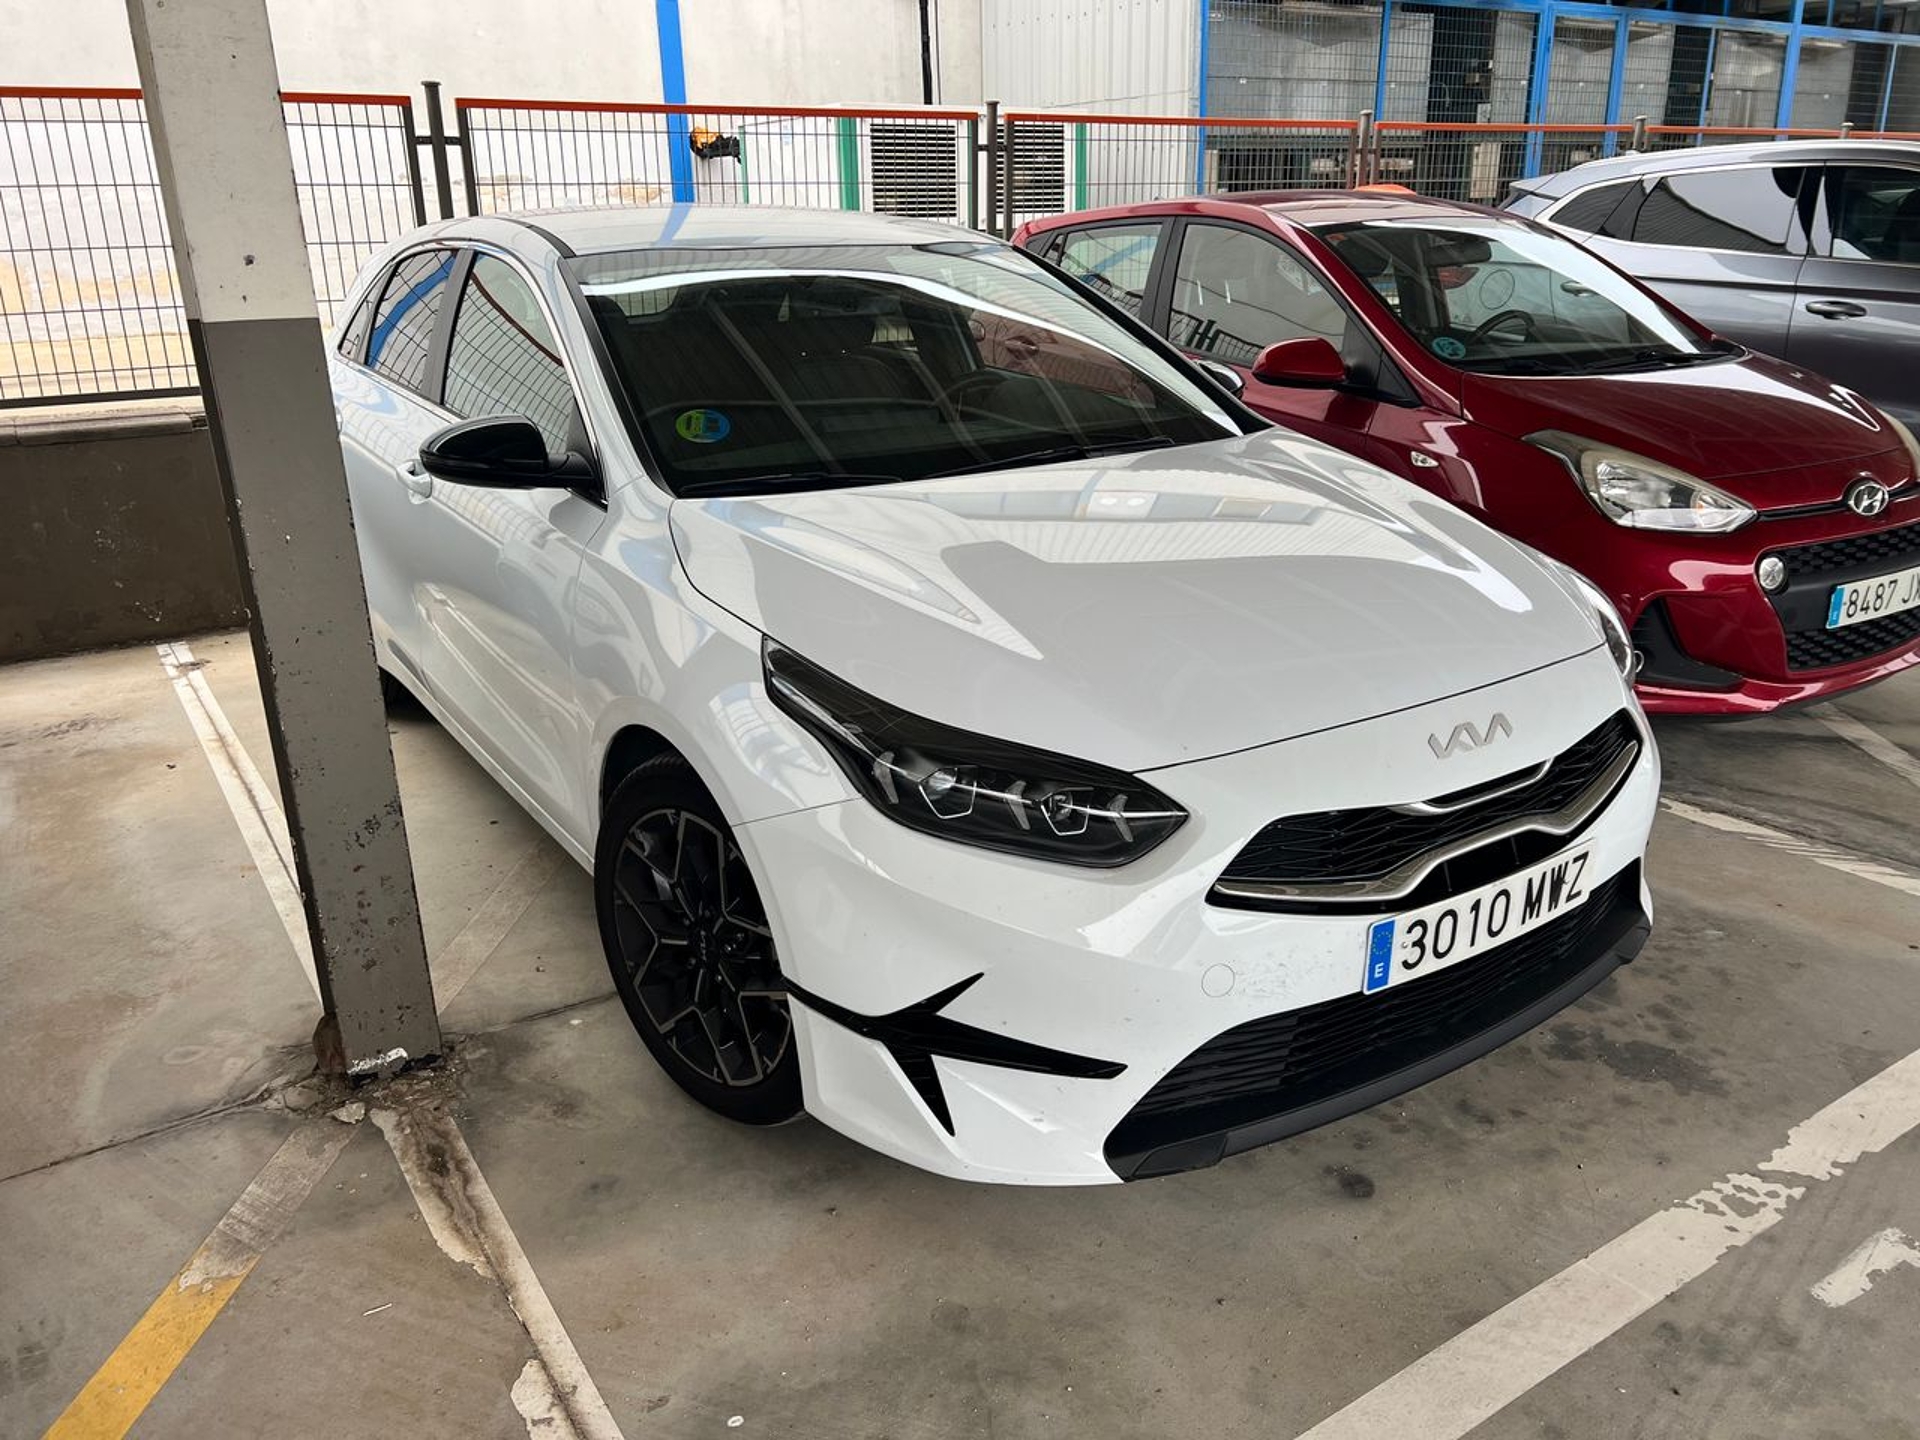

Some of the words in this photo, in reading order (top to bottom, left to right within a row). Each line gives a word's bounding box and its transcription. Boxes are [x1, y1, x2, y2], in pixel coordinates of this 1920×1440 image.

[1846, 578, 1898, 618] 8487
[1401, 888, 1511, 970] 3010
[1520, 850, 1590, 926] MWZ
[1373, 962, 1384, 979] E
